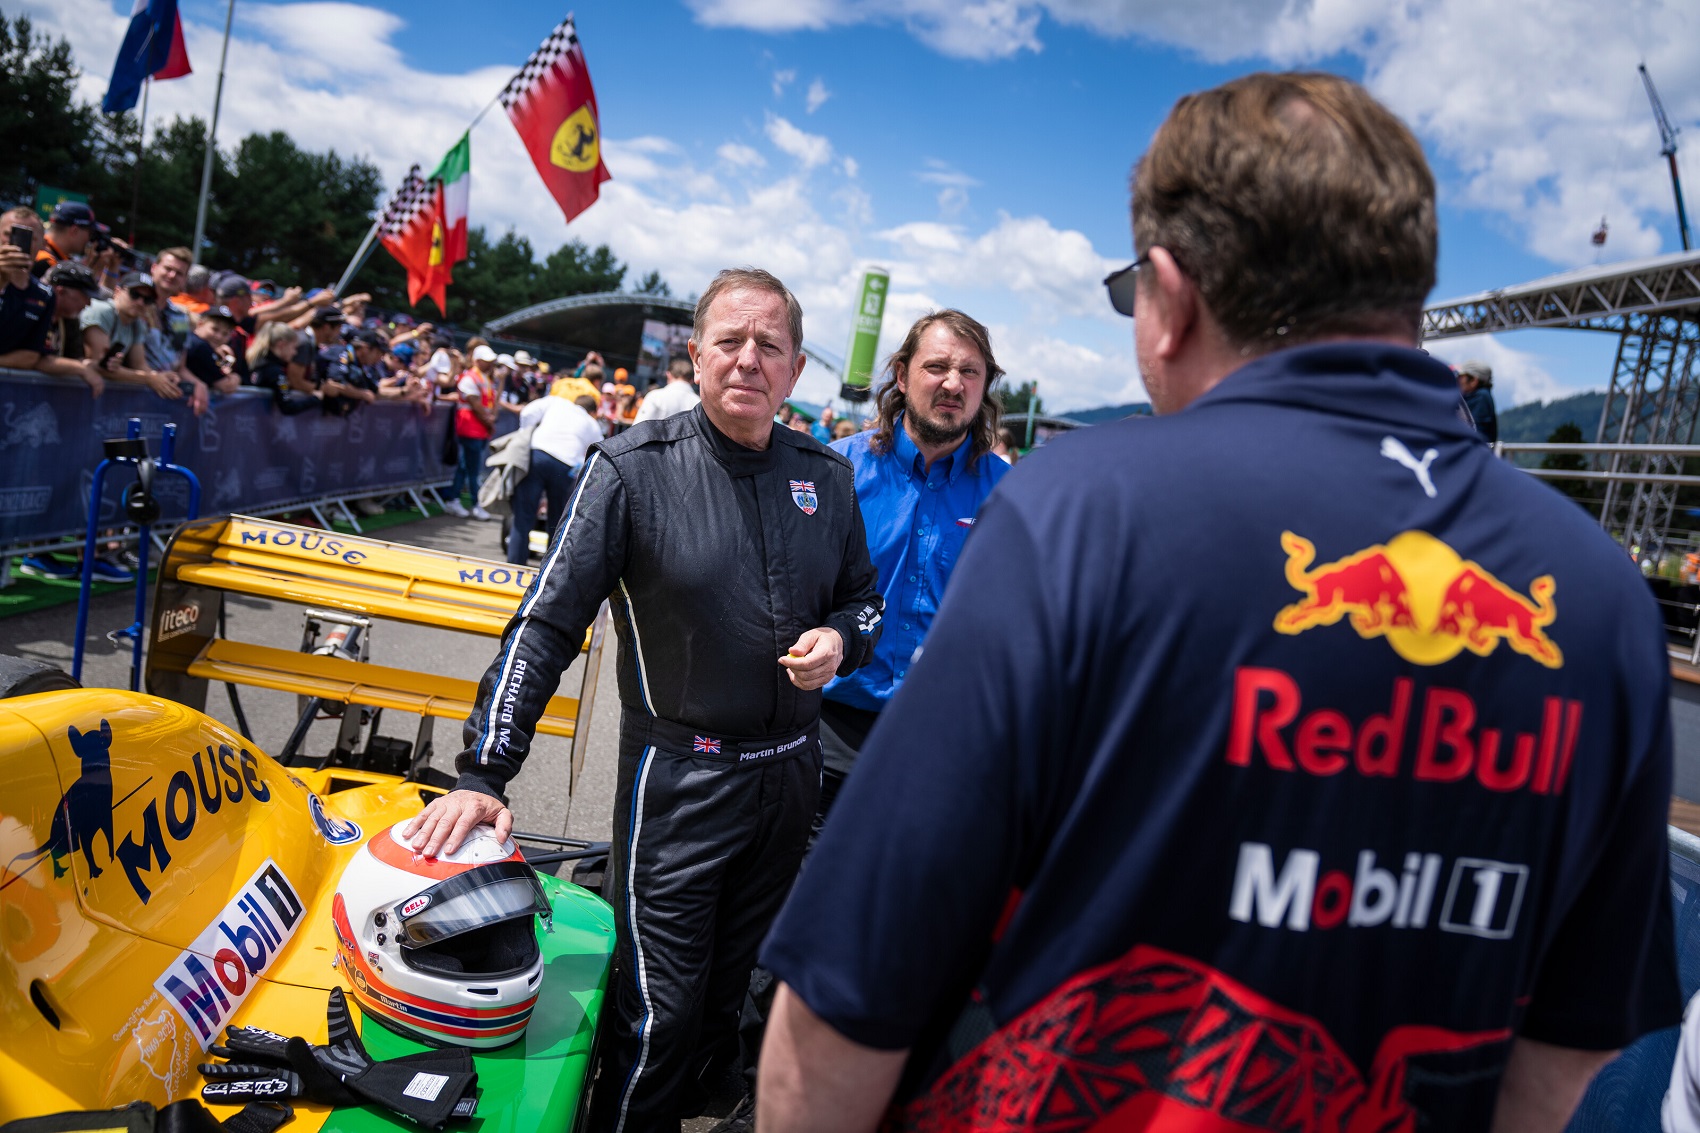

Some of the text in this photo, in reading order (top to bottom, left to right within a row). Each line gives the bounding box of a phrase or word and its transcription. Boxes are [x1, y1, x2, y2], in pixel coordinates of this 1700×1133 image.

[240, 530, 368, 565] MOUSE
[500, 658, 527, 723] RICHARD
[740, 748, 774, 761] Martin
[1224, 666, 1583, 795] Red Bull
[116, 743, 271, 906] MOUSE
[404, 899, 426, 914] BELL
[1229, 842, 1503, 932] Mobil 1
[163, 892, 283, 1042] Mobil
[113, 1021, 131, 1041] Queen
[134, 1004, 147, 1016] The
[380, 995, 408, 1013] Martin
